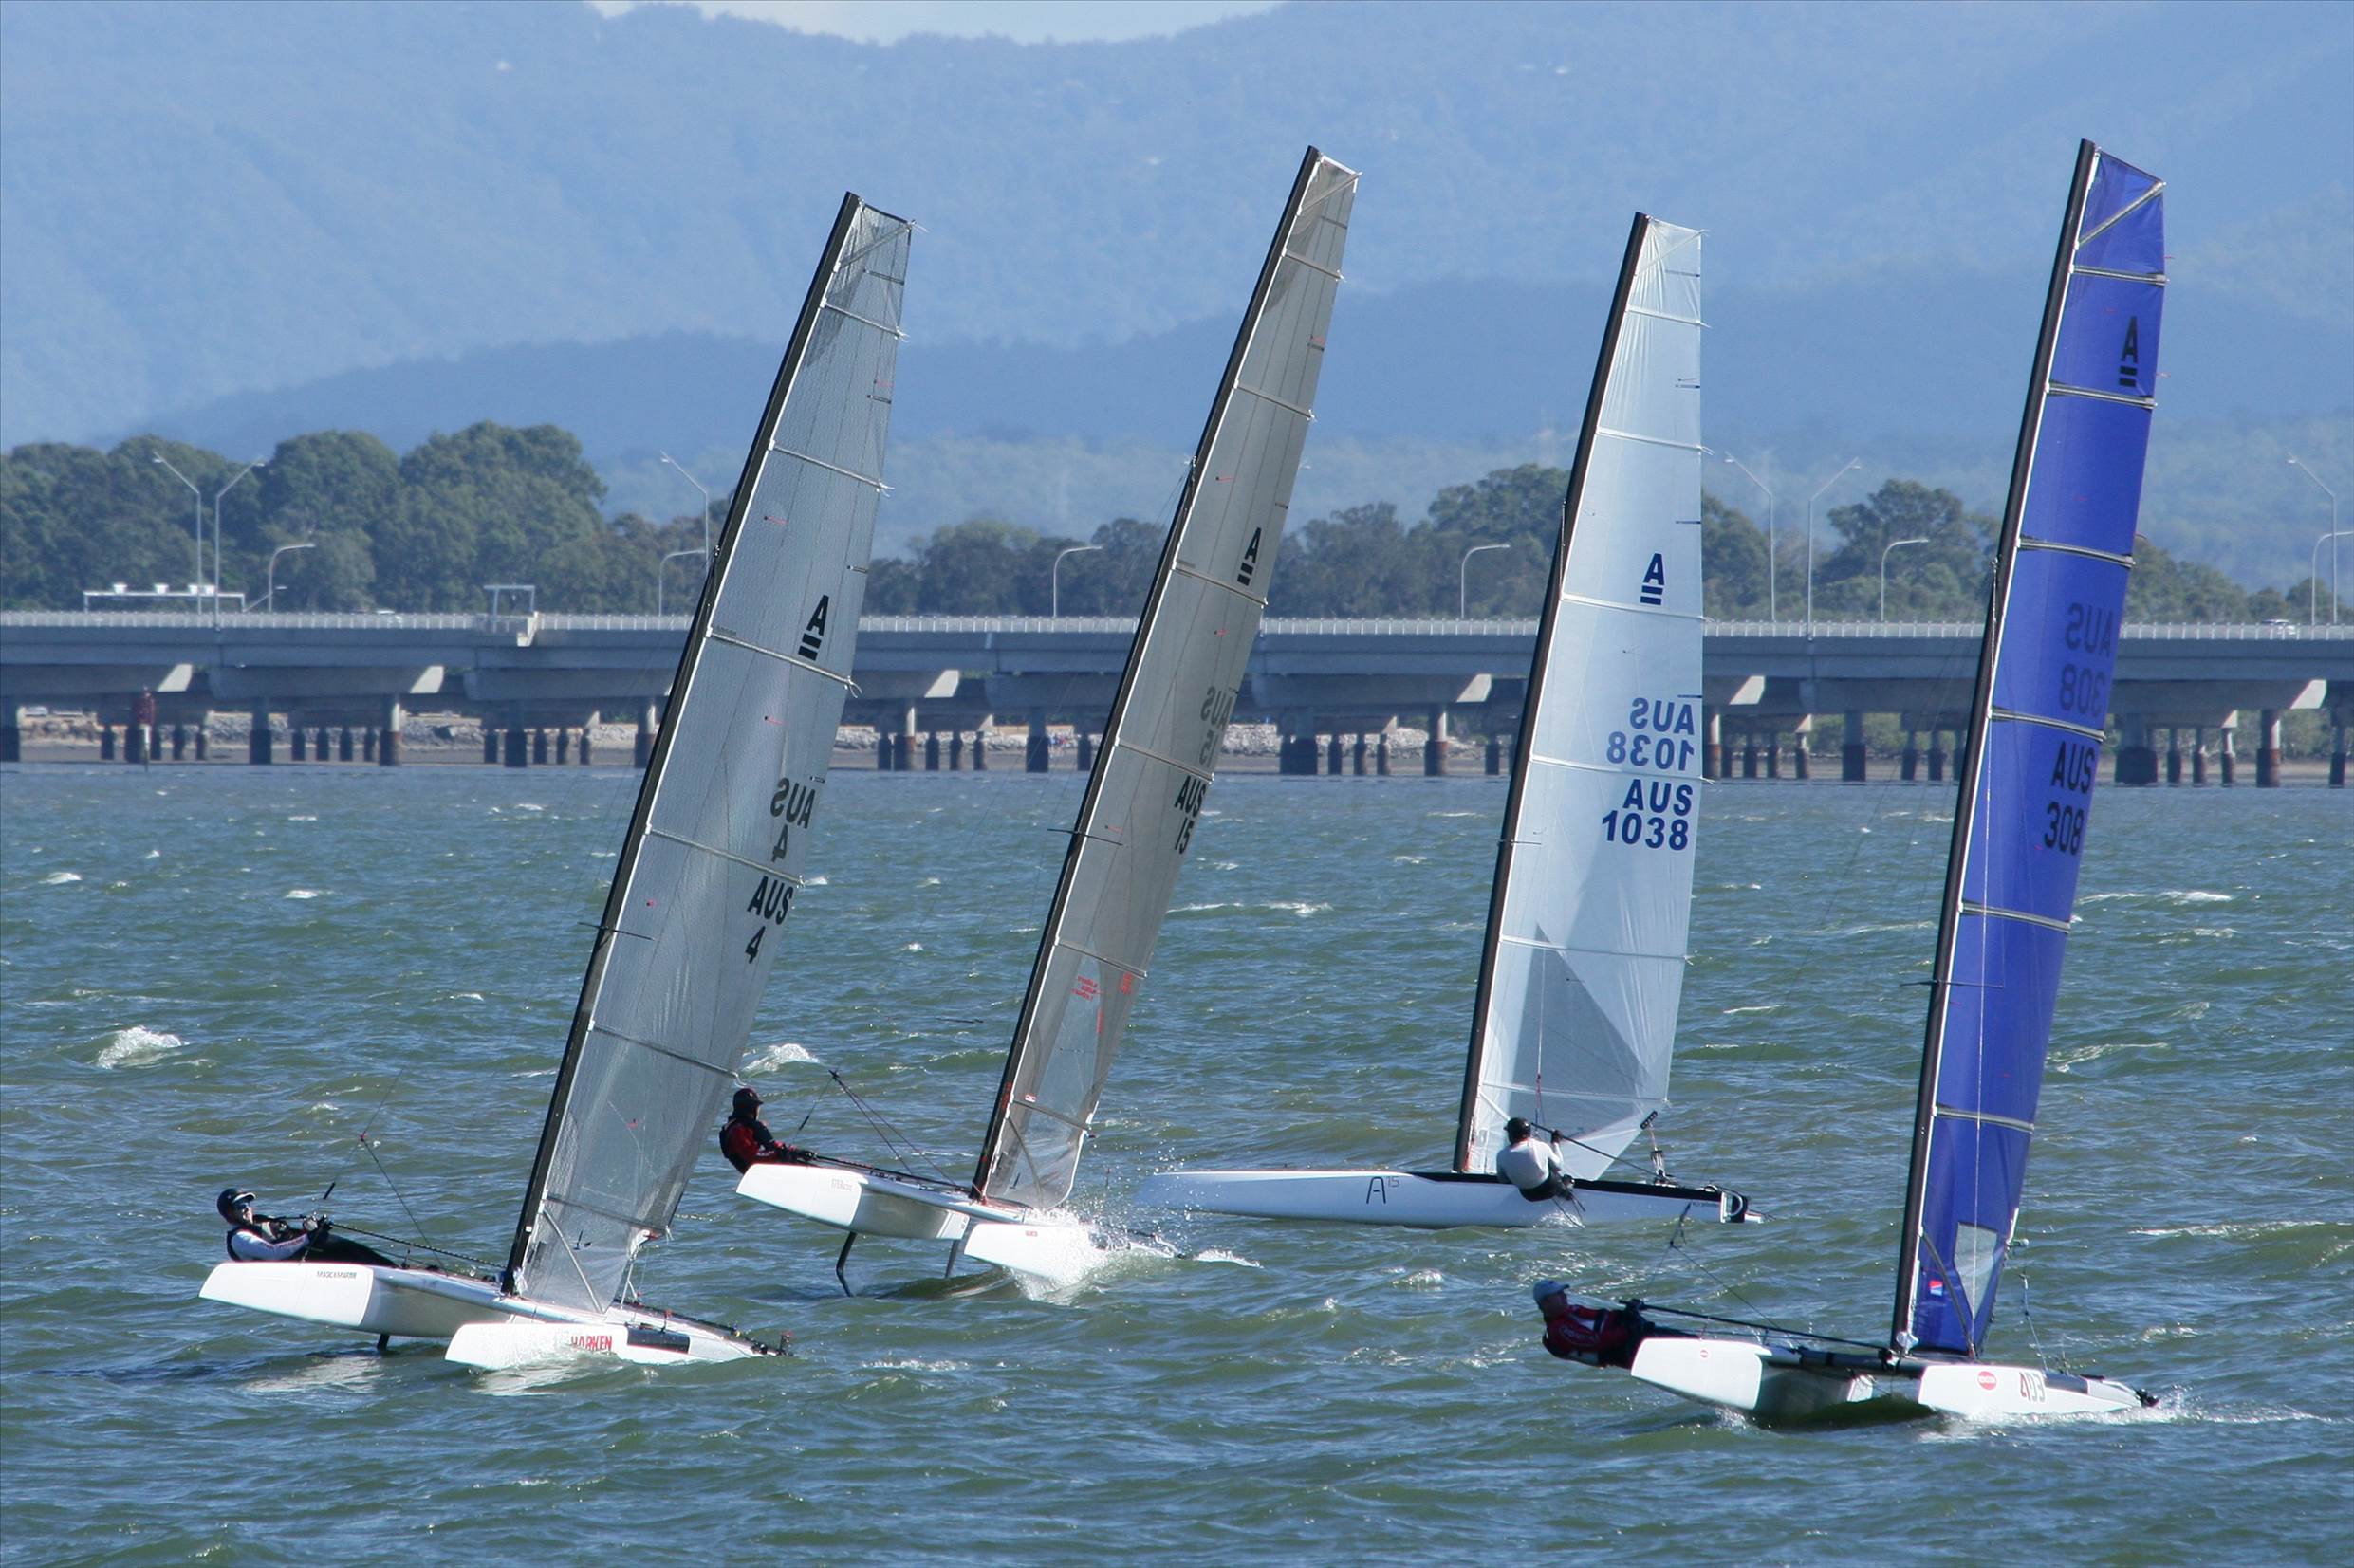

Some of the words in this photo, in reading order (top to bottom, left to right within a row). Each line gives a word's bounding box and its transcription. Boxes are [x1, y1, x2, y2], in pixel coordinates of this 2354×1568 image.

[2121, 316, 2138, 364] A
[1244, 527, 1262, 563] A
[1643, 553, 1664, 585] A
[807, 595, 829, 636] A
[2050, 741, 2095, 795] AUS
[1174, 775, 1207, 819] AUS
[1622, 779, 1693, 817] AUS
[1174, 817, 1195, 855] 15
[1601, 810, 1689, 851] 1038
[2044, 802, 2085, 855] 308
[747, 875, 793, 925] AUS
[744, 926, 766, 964] 4
